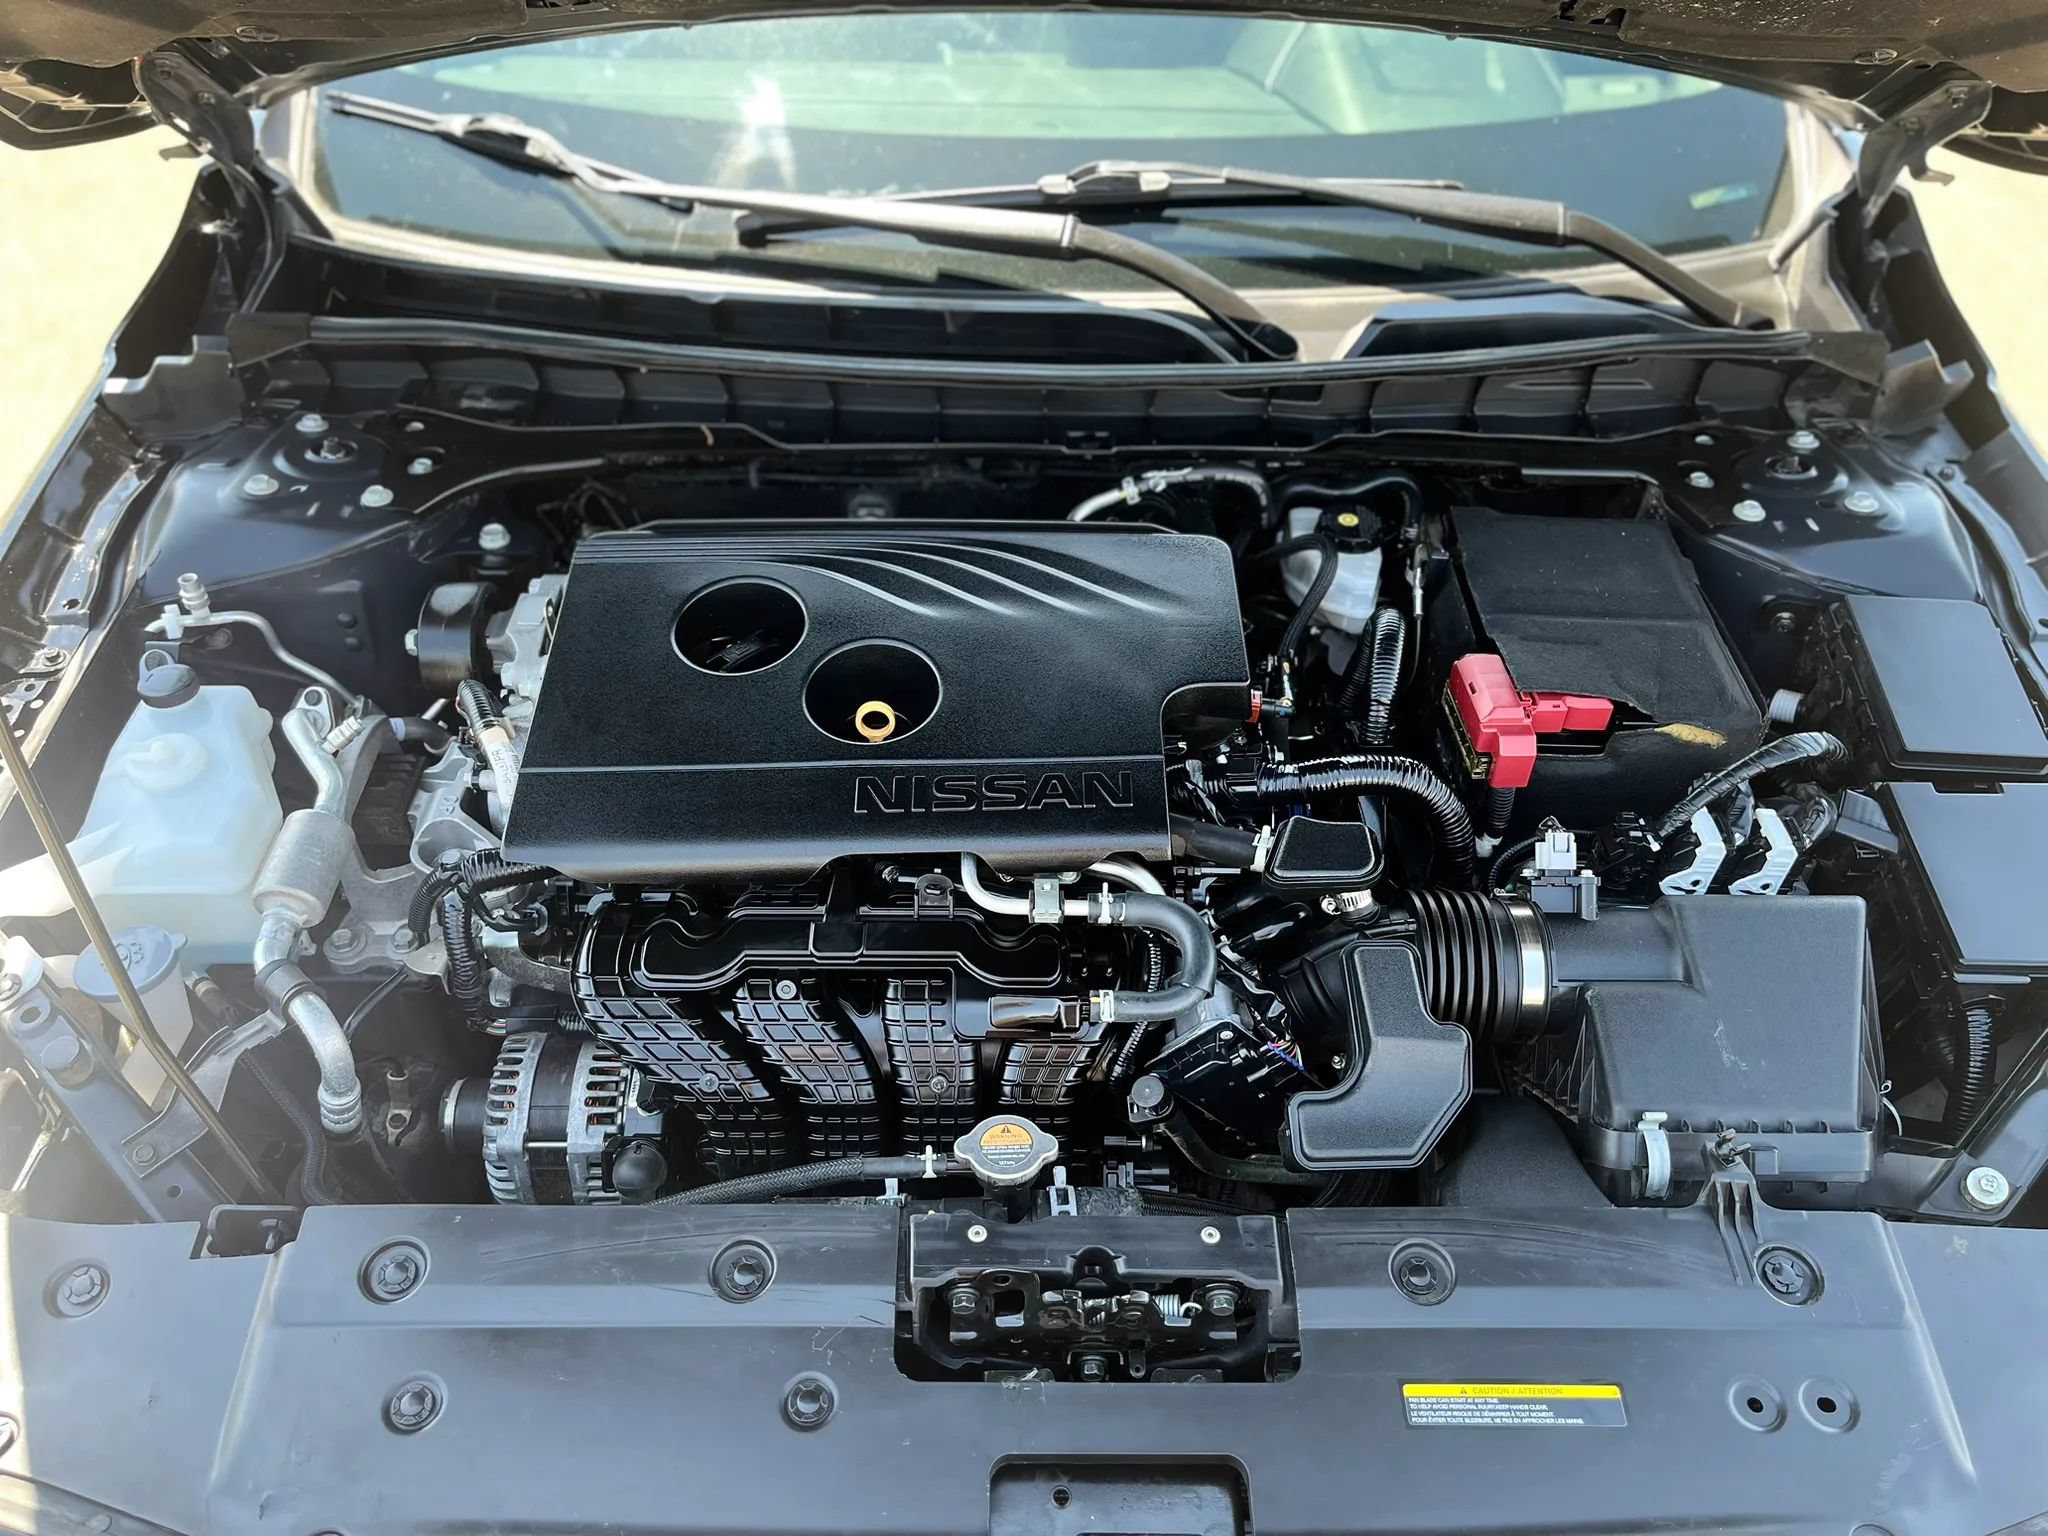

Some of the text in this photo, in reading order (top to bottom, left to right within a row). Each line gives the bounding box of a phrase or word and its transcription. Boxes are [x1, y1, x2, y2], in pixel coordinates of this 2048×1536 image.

[853, 771, 1133, 813] NISSAN
[1472, 1387, 1509, 1395] CAUTION
[1518, 1387, 1563, 1395] ATTENTION
